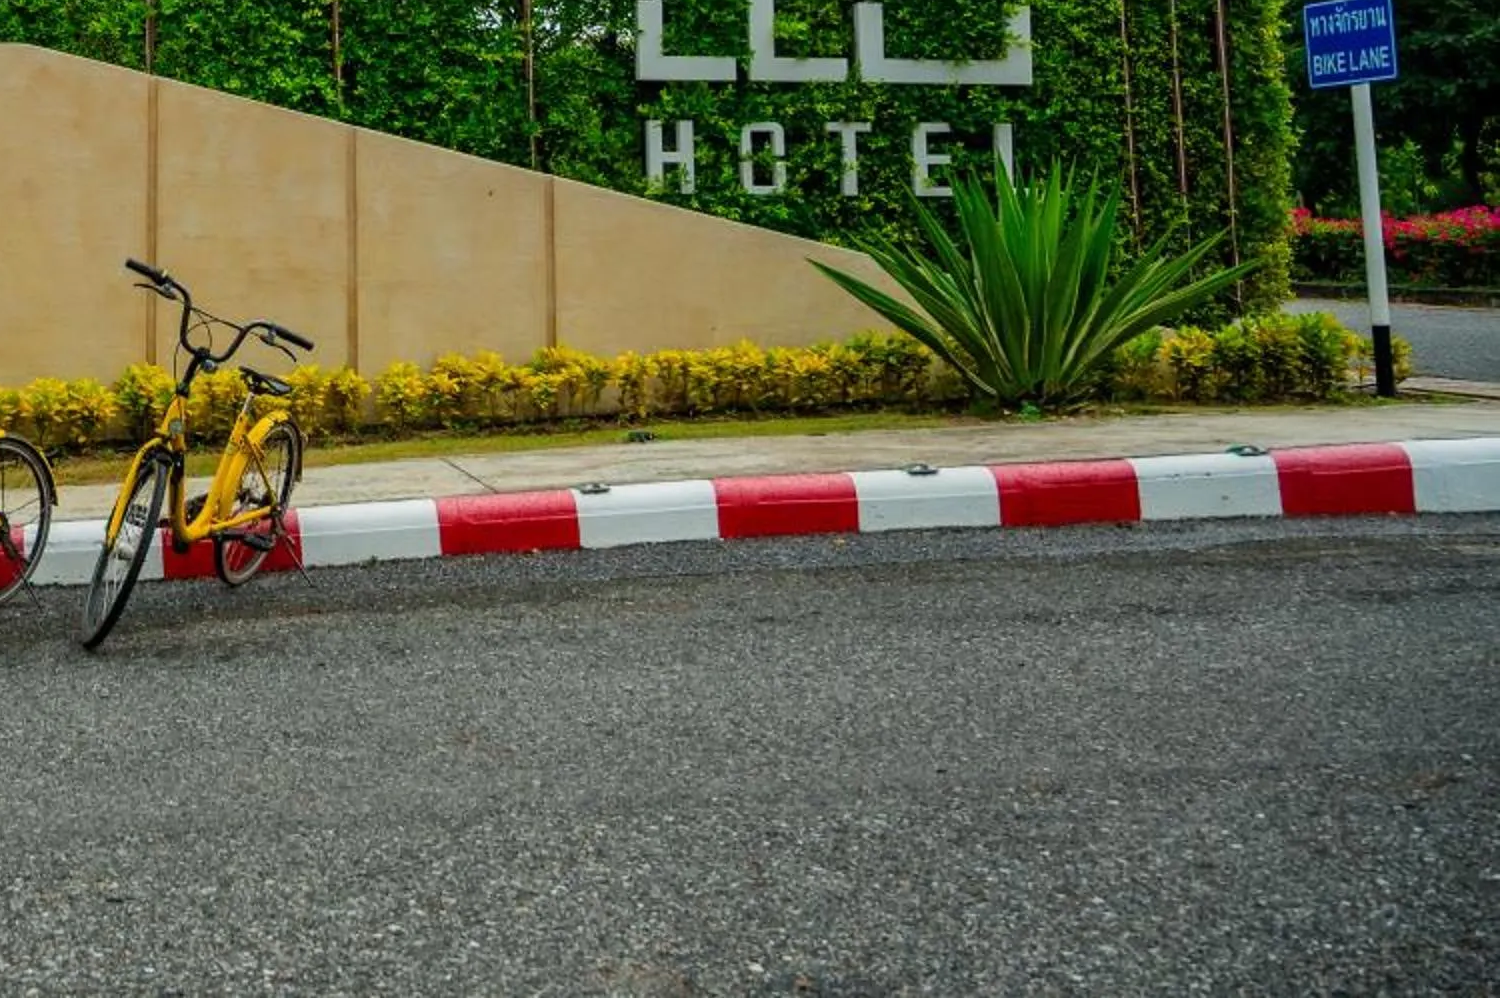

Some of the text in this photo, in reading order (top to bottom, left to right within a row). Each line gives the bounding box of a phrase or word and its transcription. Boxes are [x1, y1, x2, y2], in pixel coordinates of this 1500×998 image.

[1310, 6, 1387, 38] ทางจักรยาน
[1313, 45, 1391, 76] BIKE LANE
